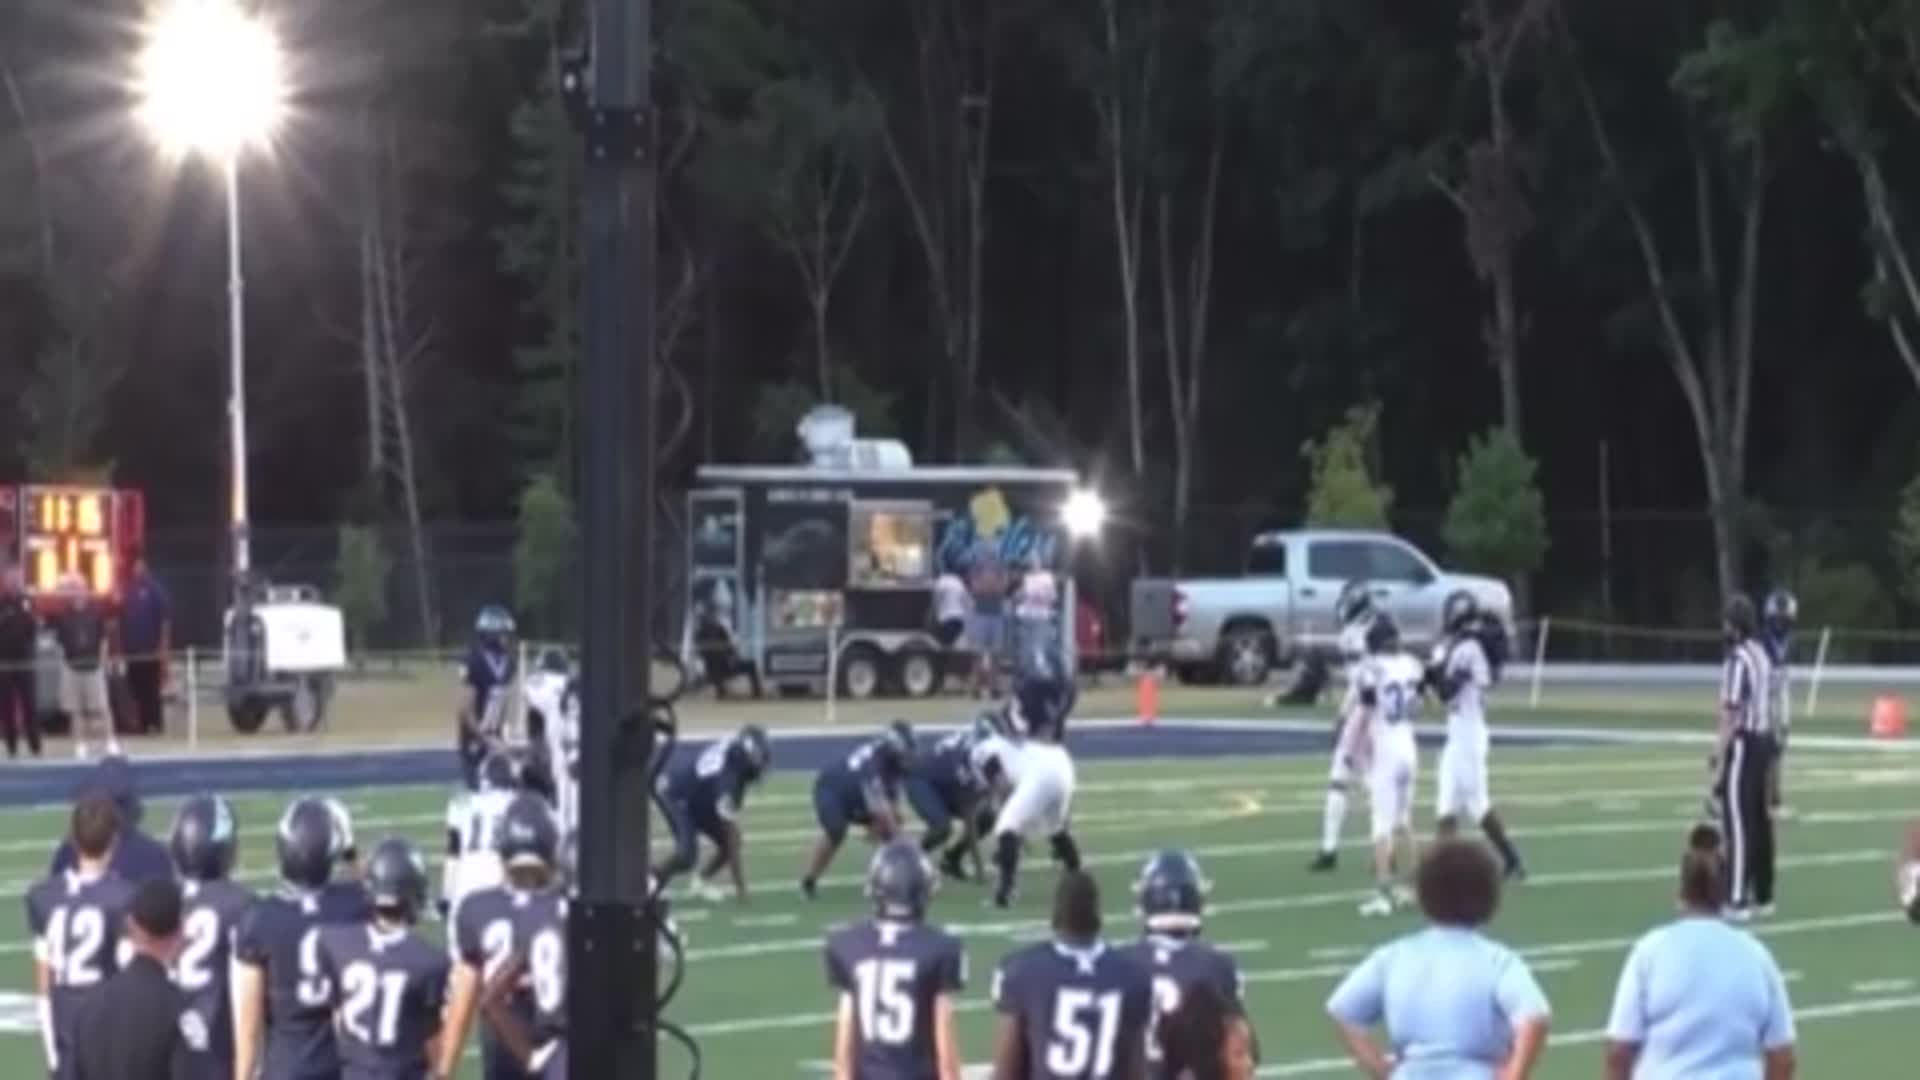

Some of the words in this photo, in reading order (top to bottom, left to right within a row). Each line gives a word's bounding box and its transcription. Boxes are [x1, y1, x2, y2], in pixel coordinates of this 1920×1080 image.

[341, 959, 408, 1045] 21
[853, 957, 916, 1044] 15
[1046, 987, 1122, 1077] 51
